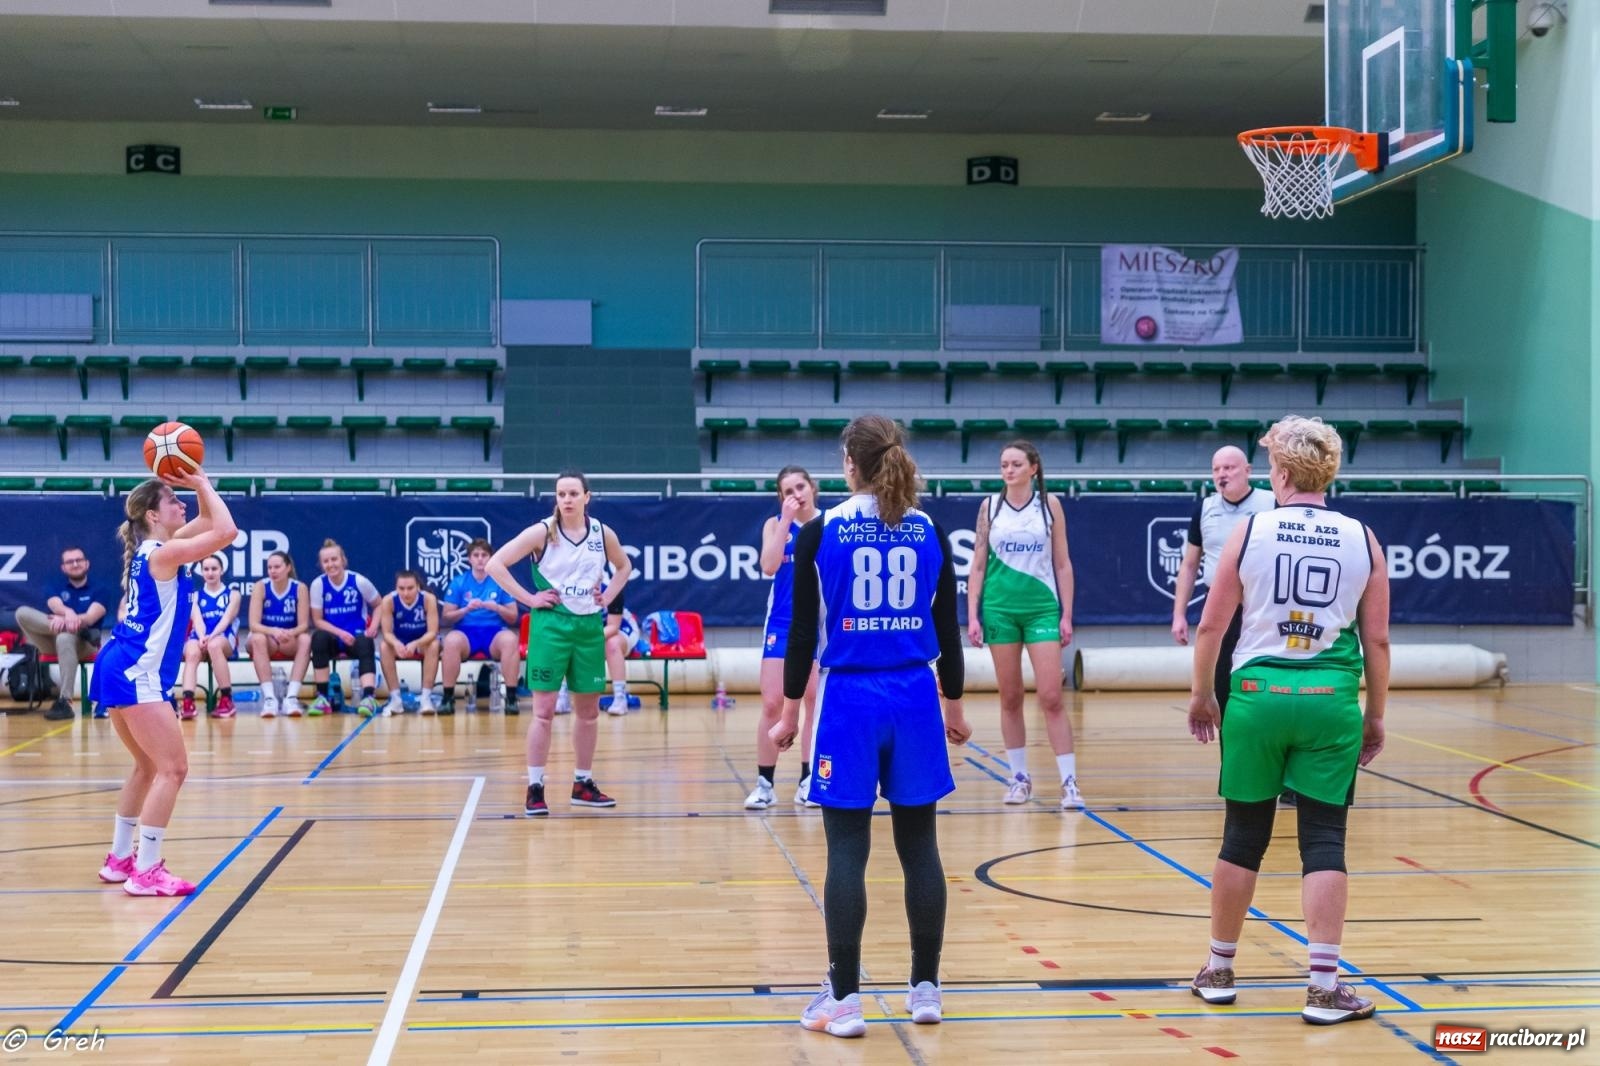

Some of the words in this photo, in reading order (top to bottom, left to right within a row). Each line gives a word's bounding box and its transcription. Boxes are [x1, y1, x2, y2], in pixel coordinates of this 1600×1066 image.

[130, 153, 144, 170] C
[156, 154, 175, 170] C
[972, 166, 991, 181] D
[1000, 166, 1015, 181] D
[838, 522, 877, 534] MKS
[883, 522, 925, 533] MOS
[1278, 521, 1306, 531] RKK
[1314, 525, 1340, 535] AZS
[838, 533, 926, 543] WROCŁAW
[1275, 533, 1341, 548] RACIBÓRZ
[1004, 540, 1045, 552] Clavis
[1386, 532, 1511, 579] BÓRZ
[852, 546, 917, 610] 88
[1273, 553, 1342, 609] 10
[343, 589, 358, 605] 22
[857, 616, 923, 631] BETARD
[1281, 621, 1321, 637] SEGET
